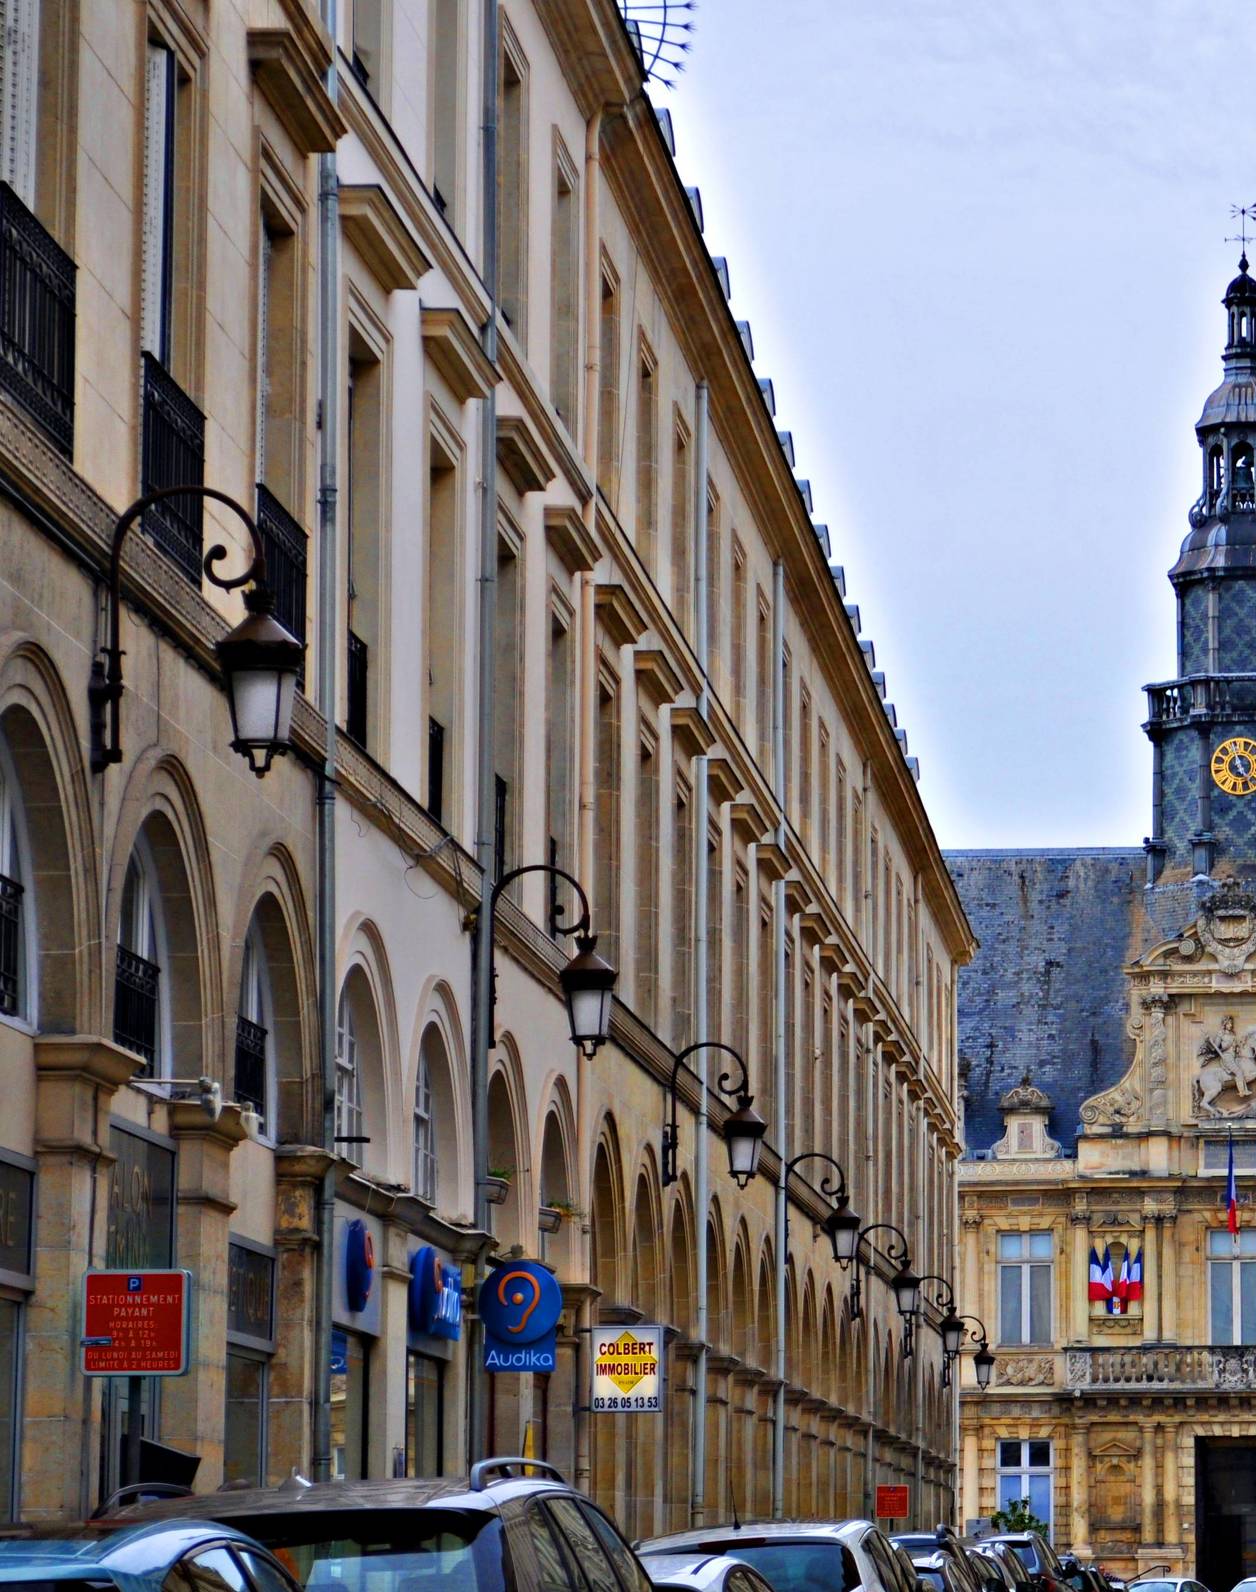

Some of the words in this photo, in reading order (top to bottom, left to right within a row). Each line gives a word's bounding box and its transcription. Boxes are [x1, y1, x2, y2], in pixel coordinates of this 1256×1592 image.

[89, 1294, 180, 1305] STATIONNEMENT
[113, 1307, 155, 1317] PAYANT
[88, 1351, 100, 1359] DU
[102, 1351, 128, 1360] LUNDI
[130, 1351, 142, 1359] AU
[145, 1350, 179, 1359] SAMEDI
[599, 1342, 654, 1356] COLBERT
[485, 1349, 553, 1367] Audika
[141, 1360, 177, 1369] HEURES
[596, 1362, 657, 1376] IMMOBILIER
[594, 1397, 605, 1409] 03
[607, 1397, 618, 1409] 26
[620, 1397, 632, 1408] 05
[634, 1396, 645, 1408] 13
[647, 1396, 658, 1408] 53
